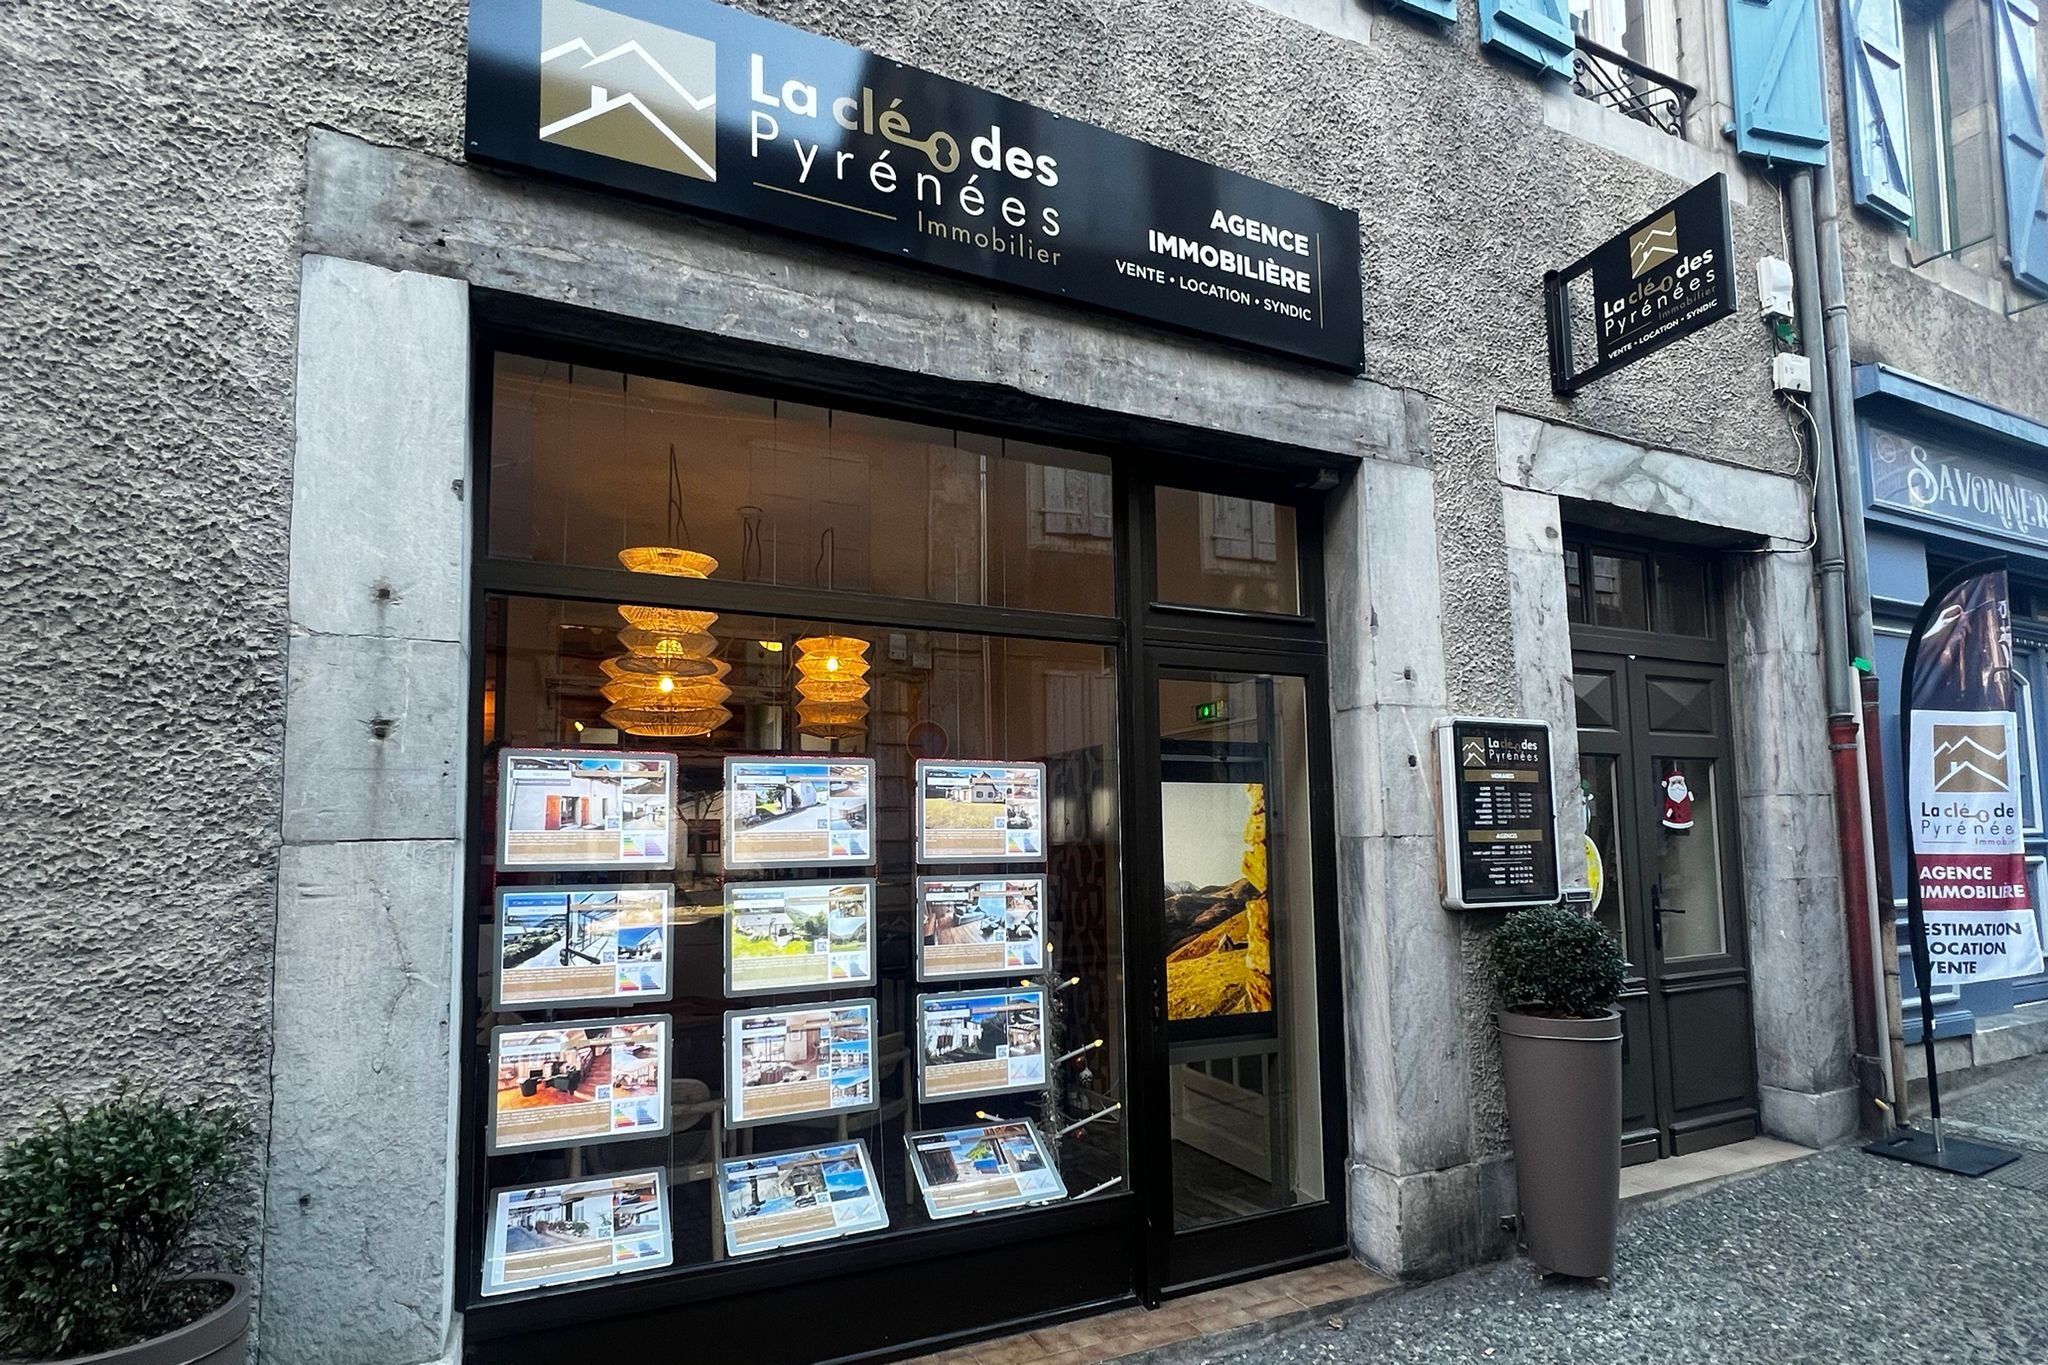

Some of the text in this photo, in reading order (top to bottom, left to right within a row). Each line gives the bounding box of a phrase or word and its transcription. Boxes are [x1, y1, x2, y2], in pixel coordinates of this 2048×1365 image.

[749, 53, 1060, 188] La clé des
[750, 111, 1061, 238] Pyrénées
[917, 210, 1062, 267] Immobilier
[1148, 228, 1312, 294] IMMOBILIÈRE
[1209, 208, 1310, 257] AGENCE
[1115, 258, 1313, 322] VENTE LOCATION SYNDIC
[1603, 248, 1715, 319] La clé des
[1604, 268, 1716, 337] Pyrénées
[1658, 285, 1716, 321] Immobilier
[1607, 298, 1718, 360] VENTE LOCATION SYNDIC
[1488, 736, 1500, 749] La
[1521, 738, 1538, 751] des
[1488, 749, 1539, 764] Pyrénées
[1921, 801, 1940, 817] La
[1943, 801, 1970, 818] clé
[1919, 865, 1993, 881] AGENCE
[1929, 941, 2007, 956] OCATION
